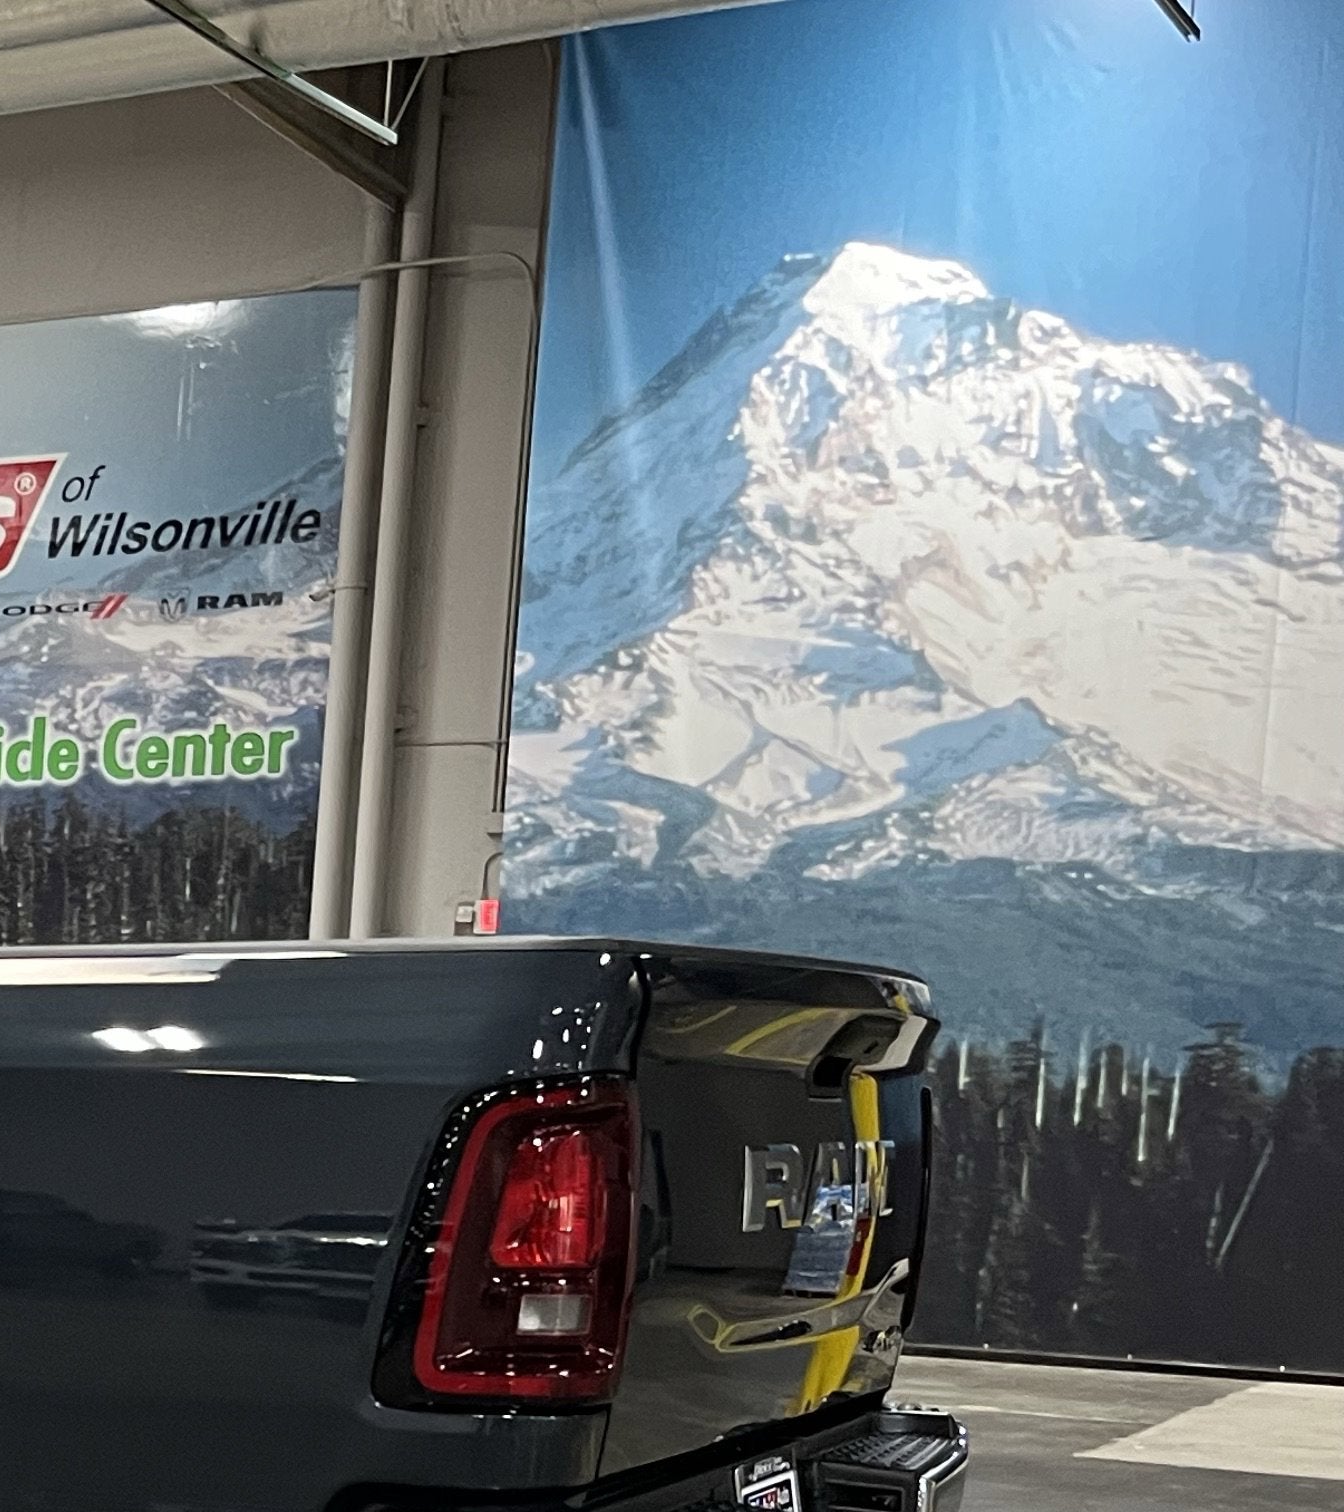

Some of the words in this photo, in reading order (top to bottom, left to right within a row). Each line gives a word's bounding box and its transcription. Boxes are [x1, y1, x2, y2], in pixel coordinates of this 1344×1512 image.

[62, 465, 106, 502] of
[47, 499, 321, 559] Wilsonville
[197, 591, 283, 610] RAM
[103, 716, 295, 780] Center
